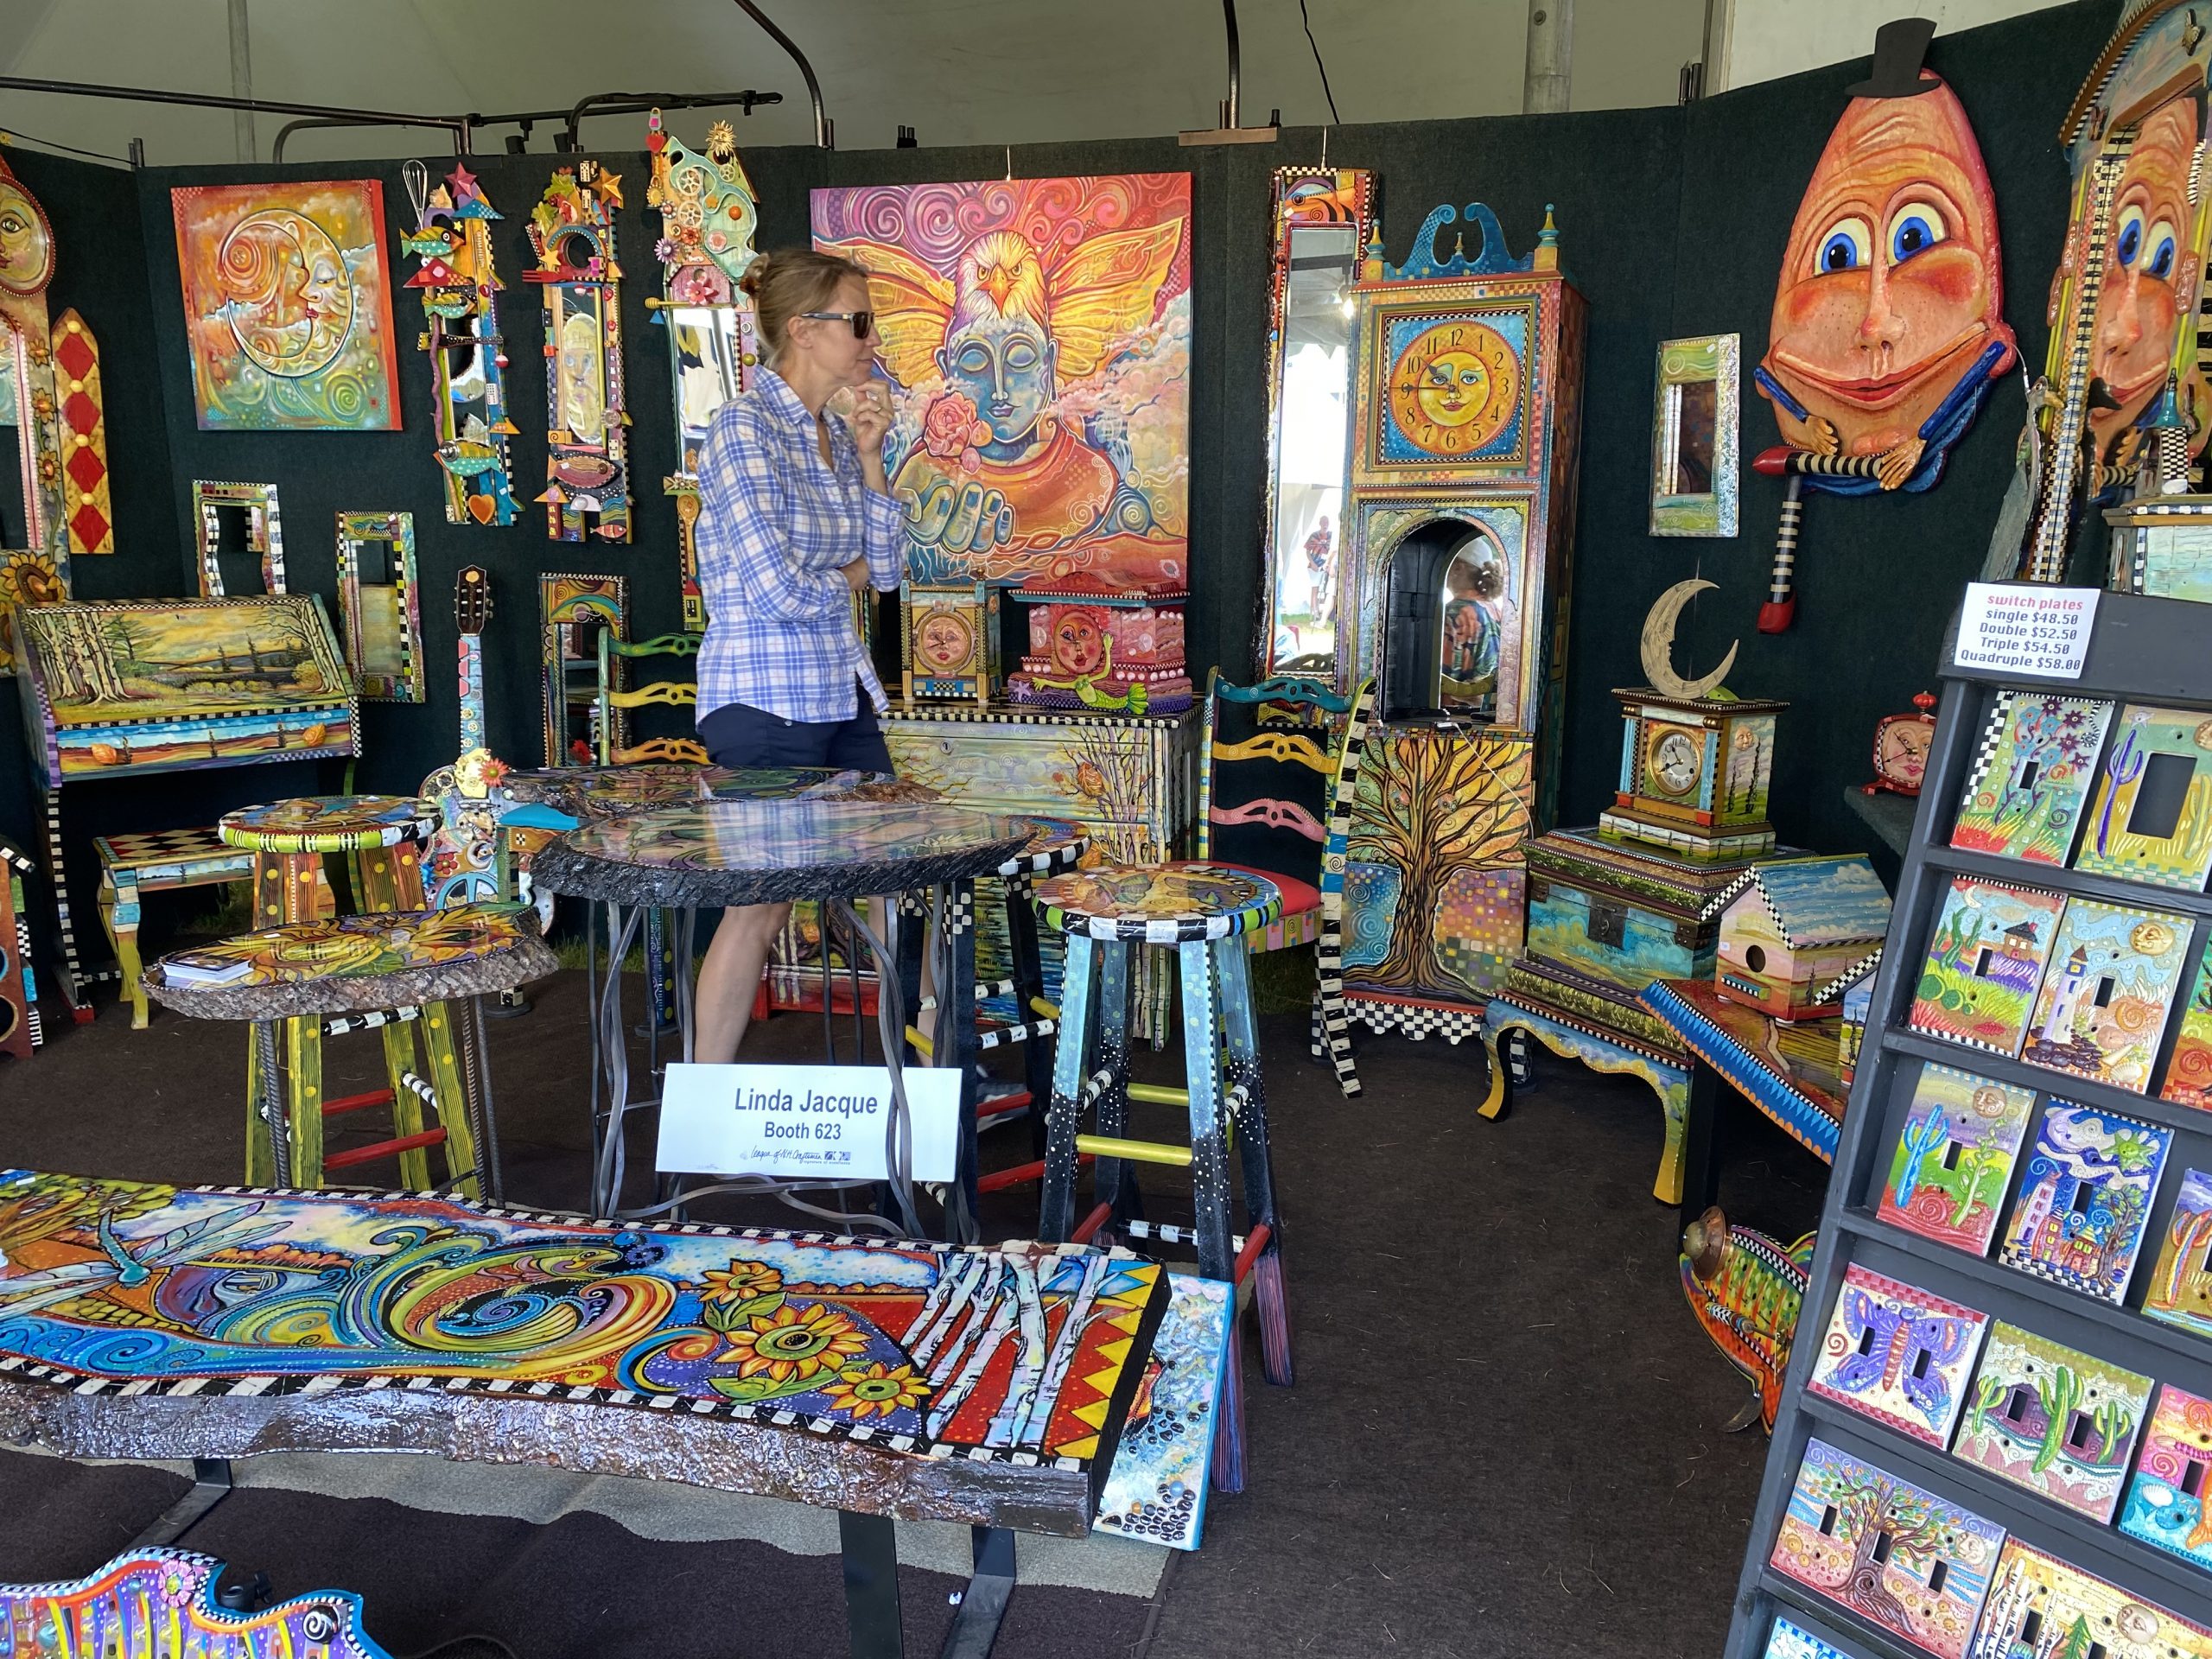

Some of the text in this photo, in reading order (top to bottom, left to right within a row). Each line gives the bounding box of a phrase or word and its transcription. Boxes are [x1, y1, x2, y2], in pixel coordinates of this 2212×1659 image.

[1426, 336, 1437, 355] 11
[1450, 327, 1464, 346] 12
[1478, 334, 1484, 353] 1
[1406, 355, 1421, 375] 10
[1494, 351, 1504, 371] 2
[1401, 382, 1411, 400] 9
[1499, 378, 1510, 396] 3
[1405, 406, 1415, 425] 8
[1491, 404, 1499, 422] 4
[1423, 424, 1433, 443] 7
[1446, 429, 1456, 449] 6
[1471, 423, 1481, 442] 5
[1986, 594, 2083, 611] switch plates
[1986, 608, 2078, 626] single $48.50
[1980, 622, 2078, 640] Double $52.50
[1980, 636, 2070, 655] Triple $54.50
[1961, 649, 2082, 671] Quadruple $58.00
[734, 1087, 879, 1119] Linda Jacque
[765, 1122, 842, 1141] Booth 623
[751, 1145, 772, 1161] League
